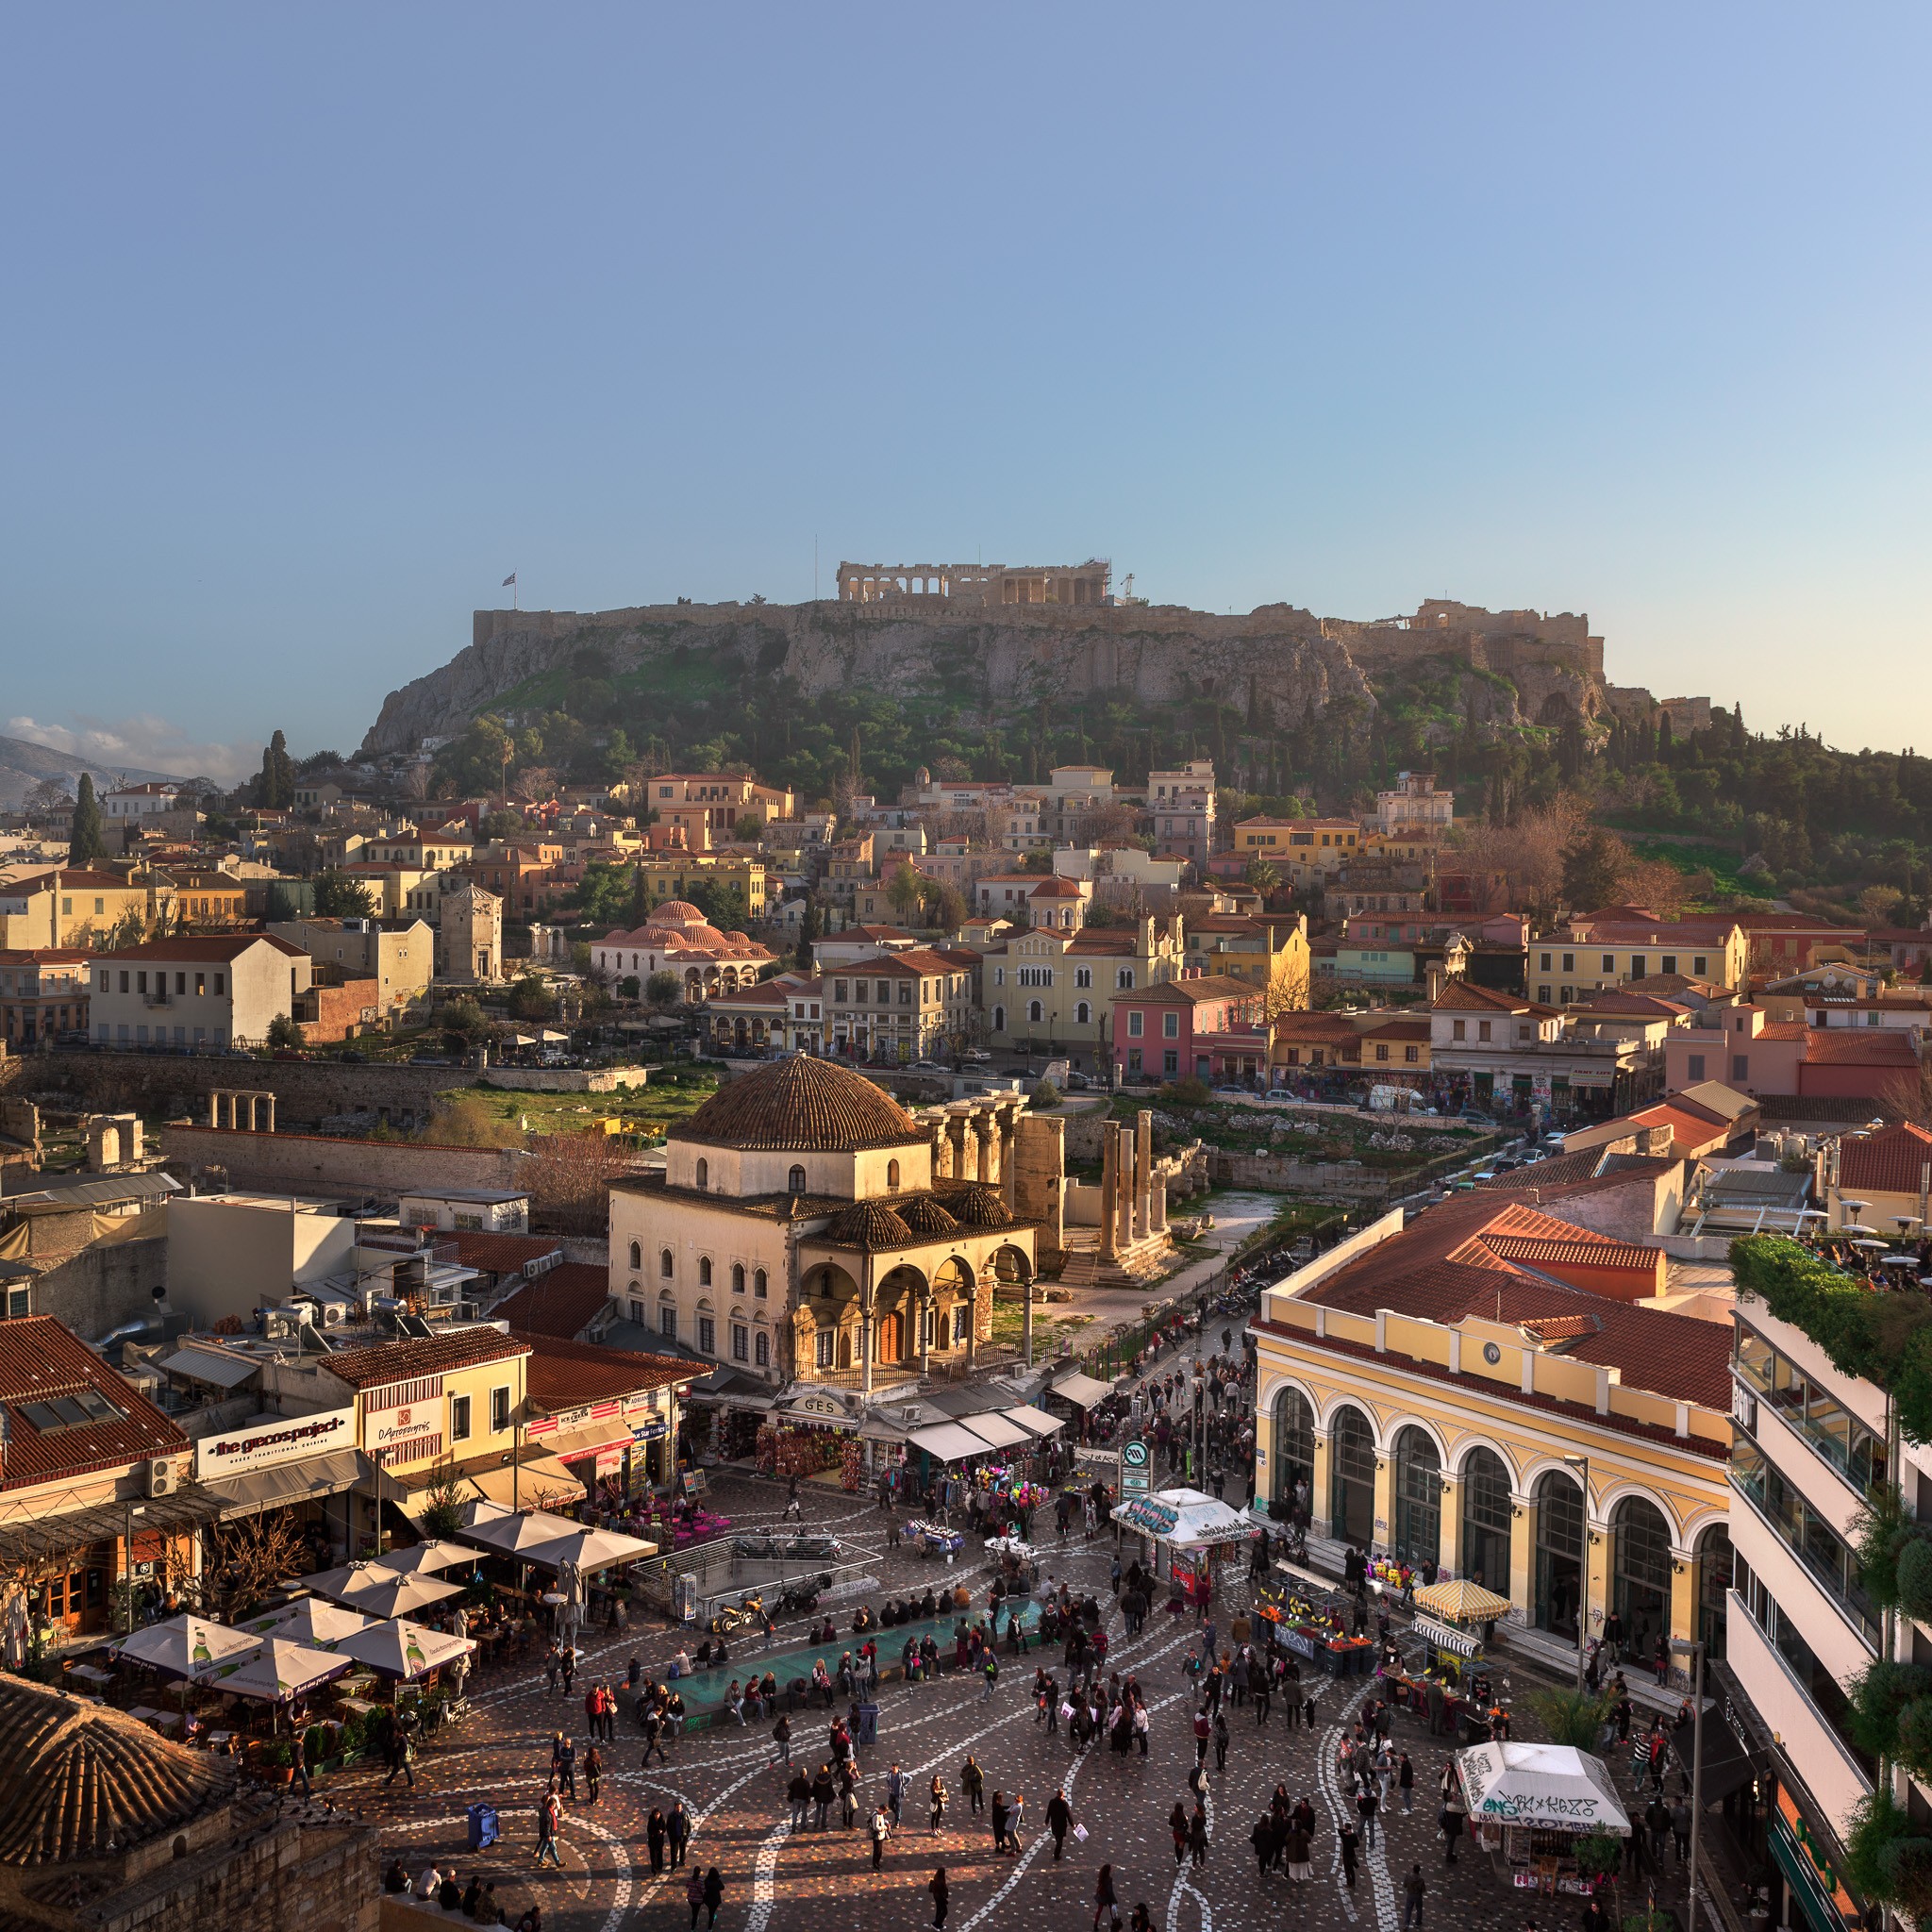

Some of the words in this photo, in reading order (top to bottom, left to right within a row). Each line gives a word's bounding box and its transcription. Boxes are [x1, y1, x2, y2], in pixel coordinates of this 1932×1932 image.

[215, 1441, 241, 1457] the
[291, 1417, 339, 1443] project
[255, 1445, 297, 1458] TRADITIONAL
[302, 1439, 327, 1447] CUISINE
